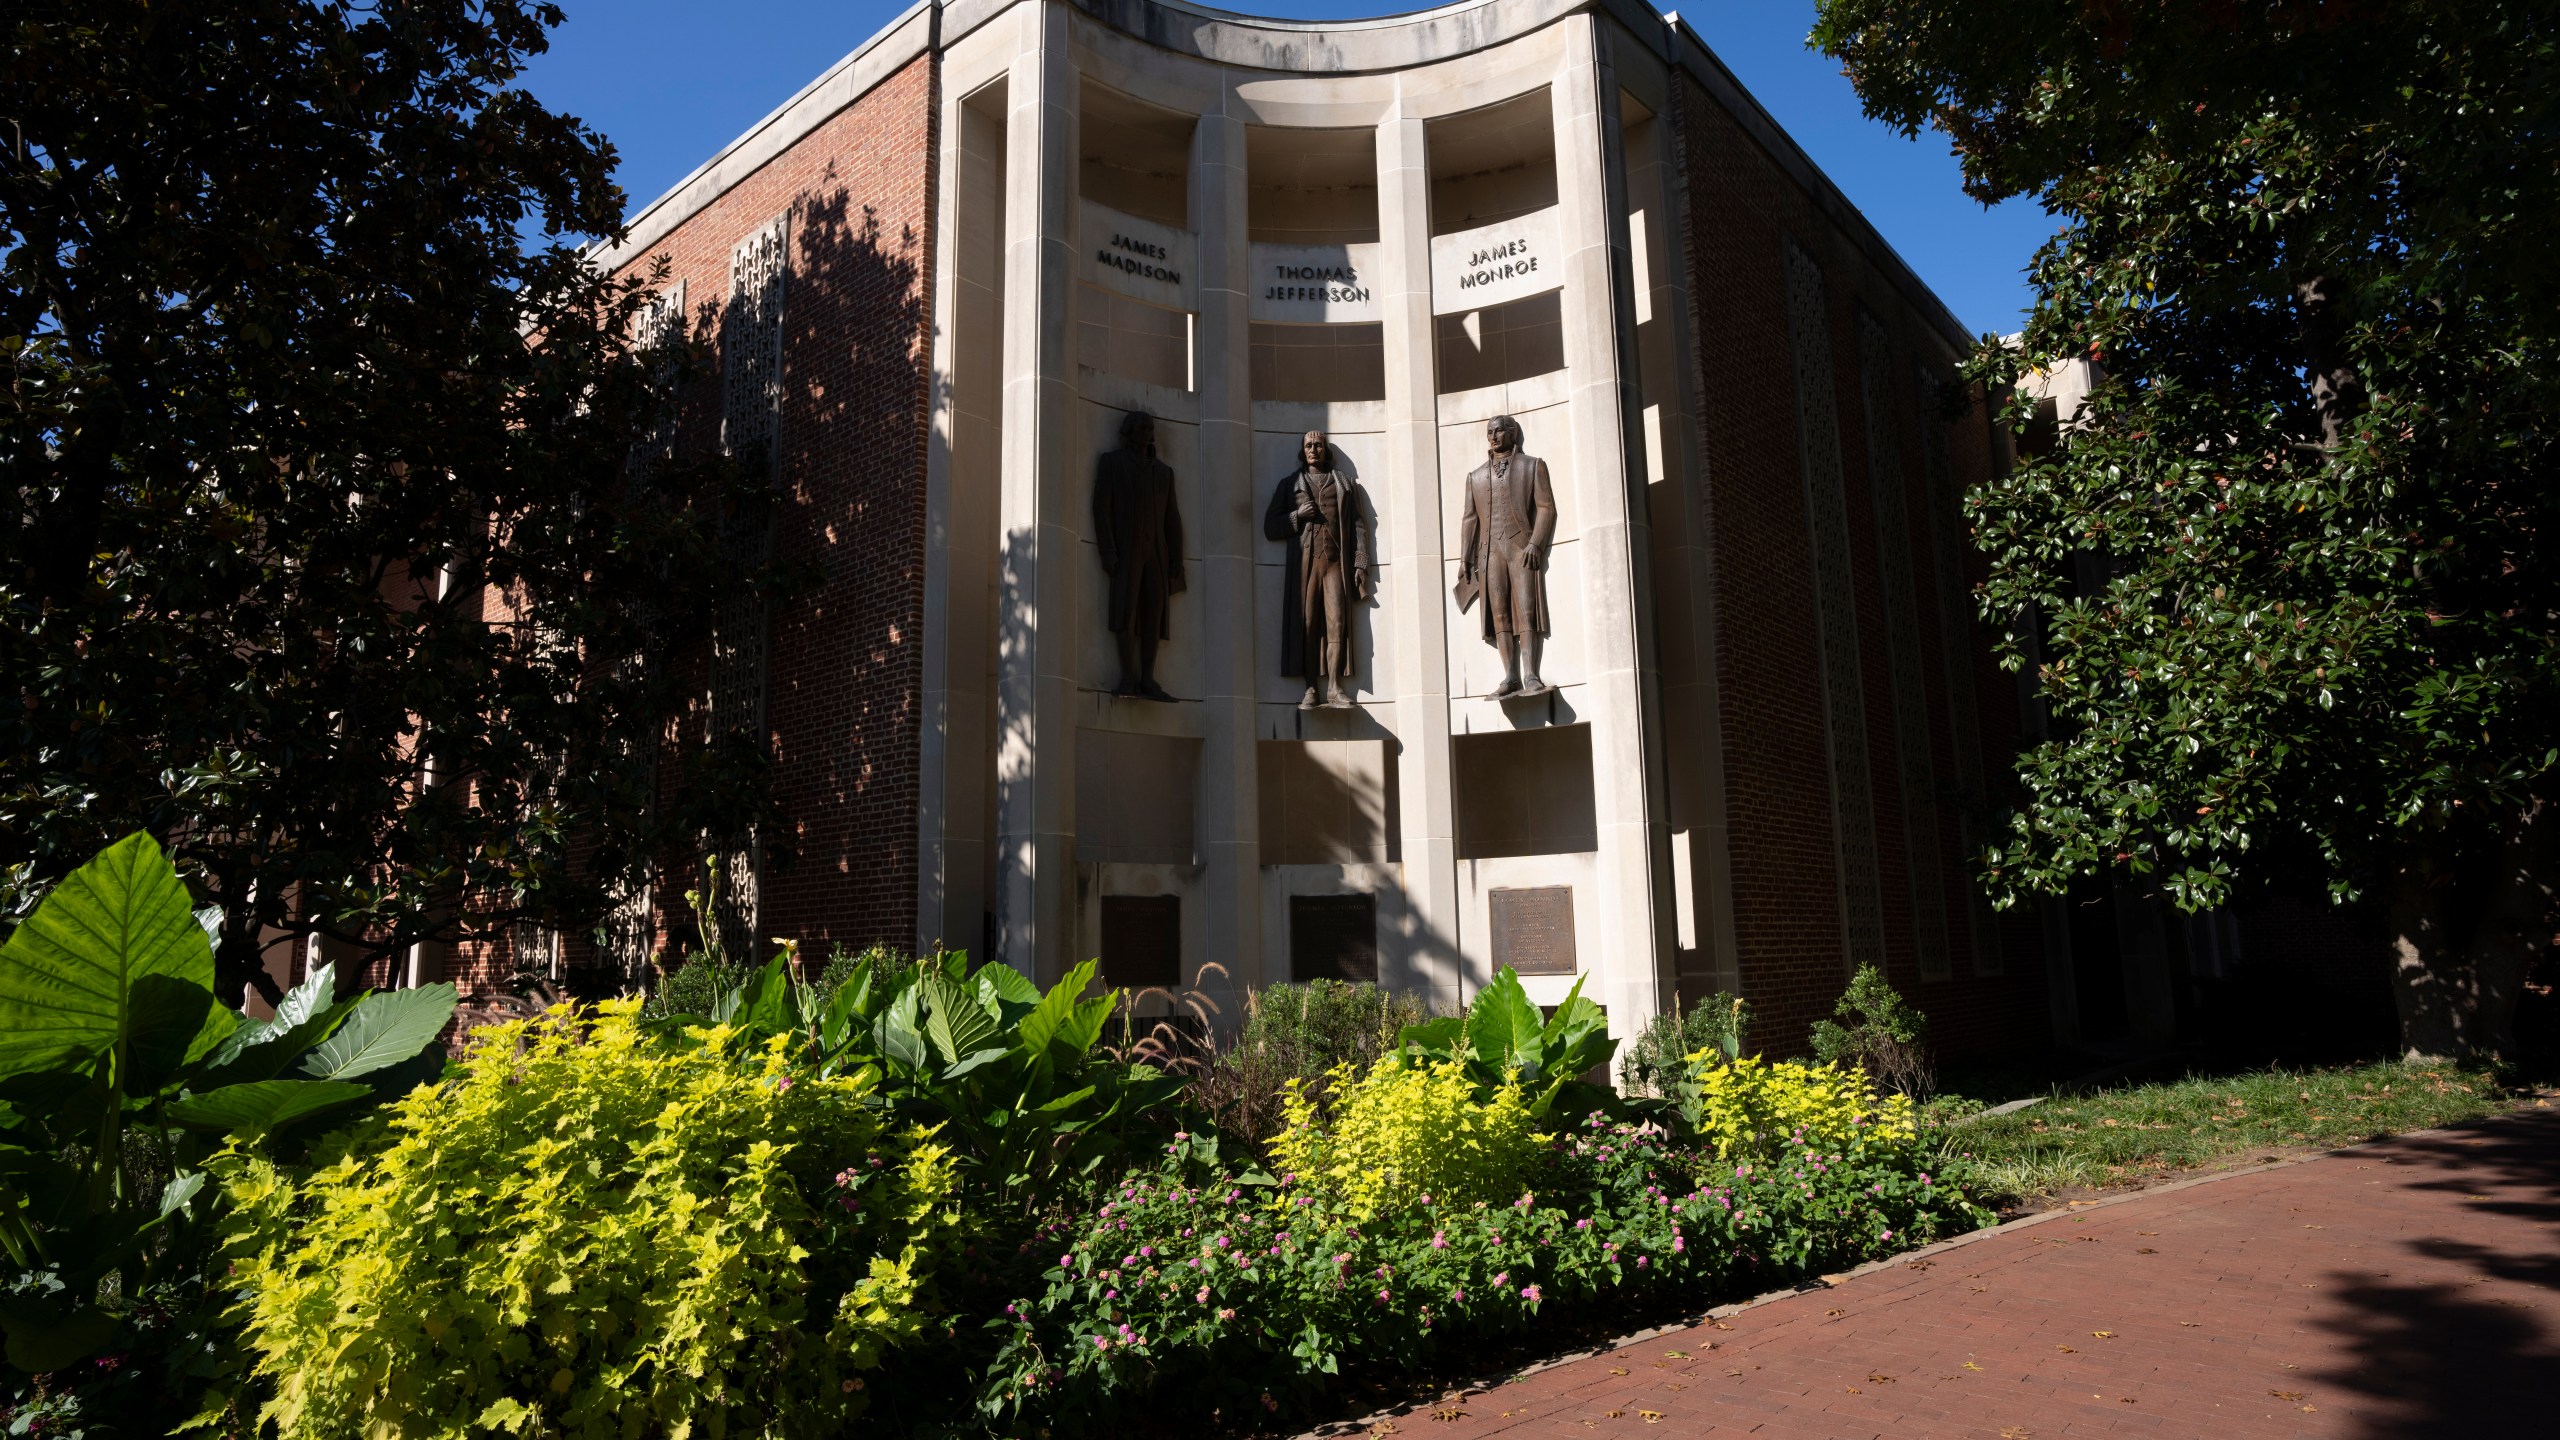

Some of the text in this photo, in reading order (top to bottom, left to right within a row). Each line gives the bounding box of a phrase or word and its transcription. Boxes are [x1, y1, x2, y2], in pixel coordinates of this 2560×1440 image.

[1111, 234, 1166, 260] JAMES
[1468, 239, 1527, 267] JAMES
[1098, 250, 1180, 285] MADISON
[1276, 265, 1357, 281] THOMAS
[1460, 257, 1538, 290] MONROE
[1265, 287, 1370, 302] JEFFERSON
